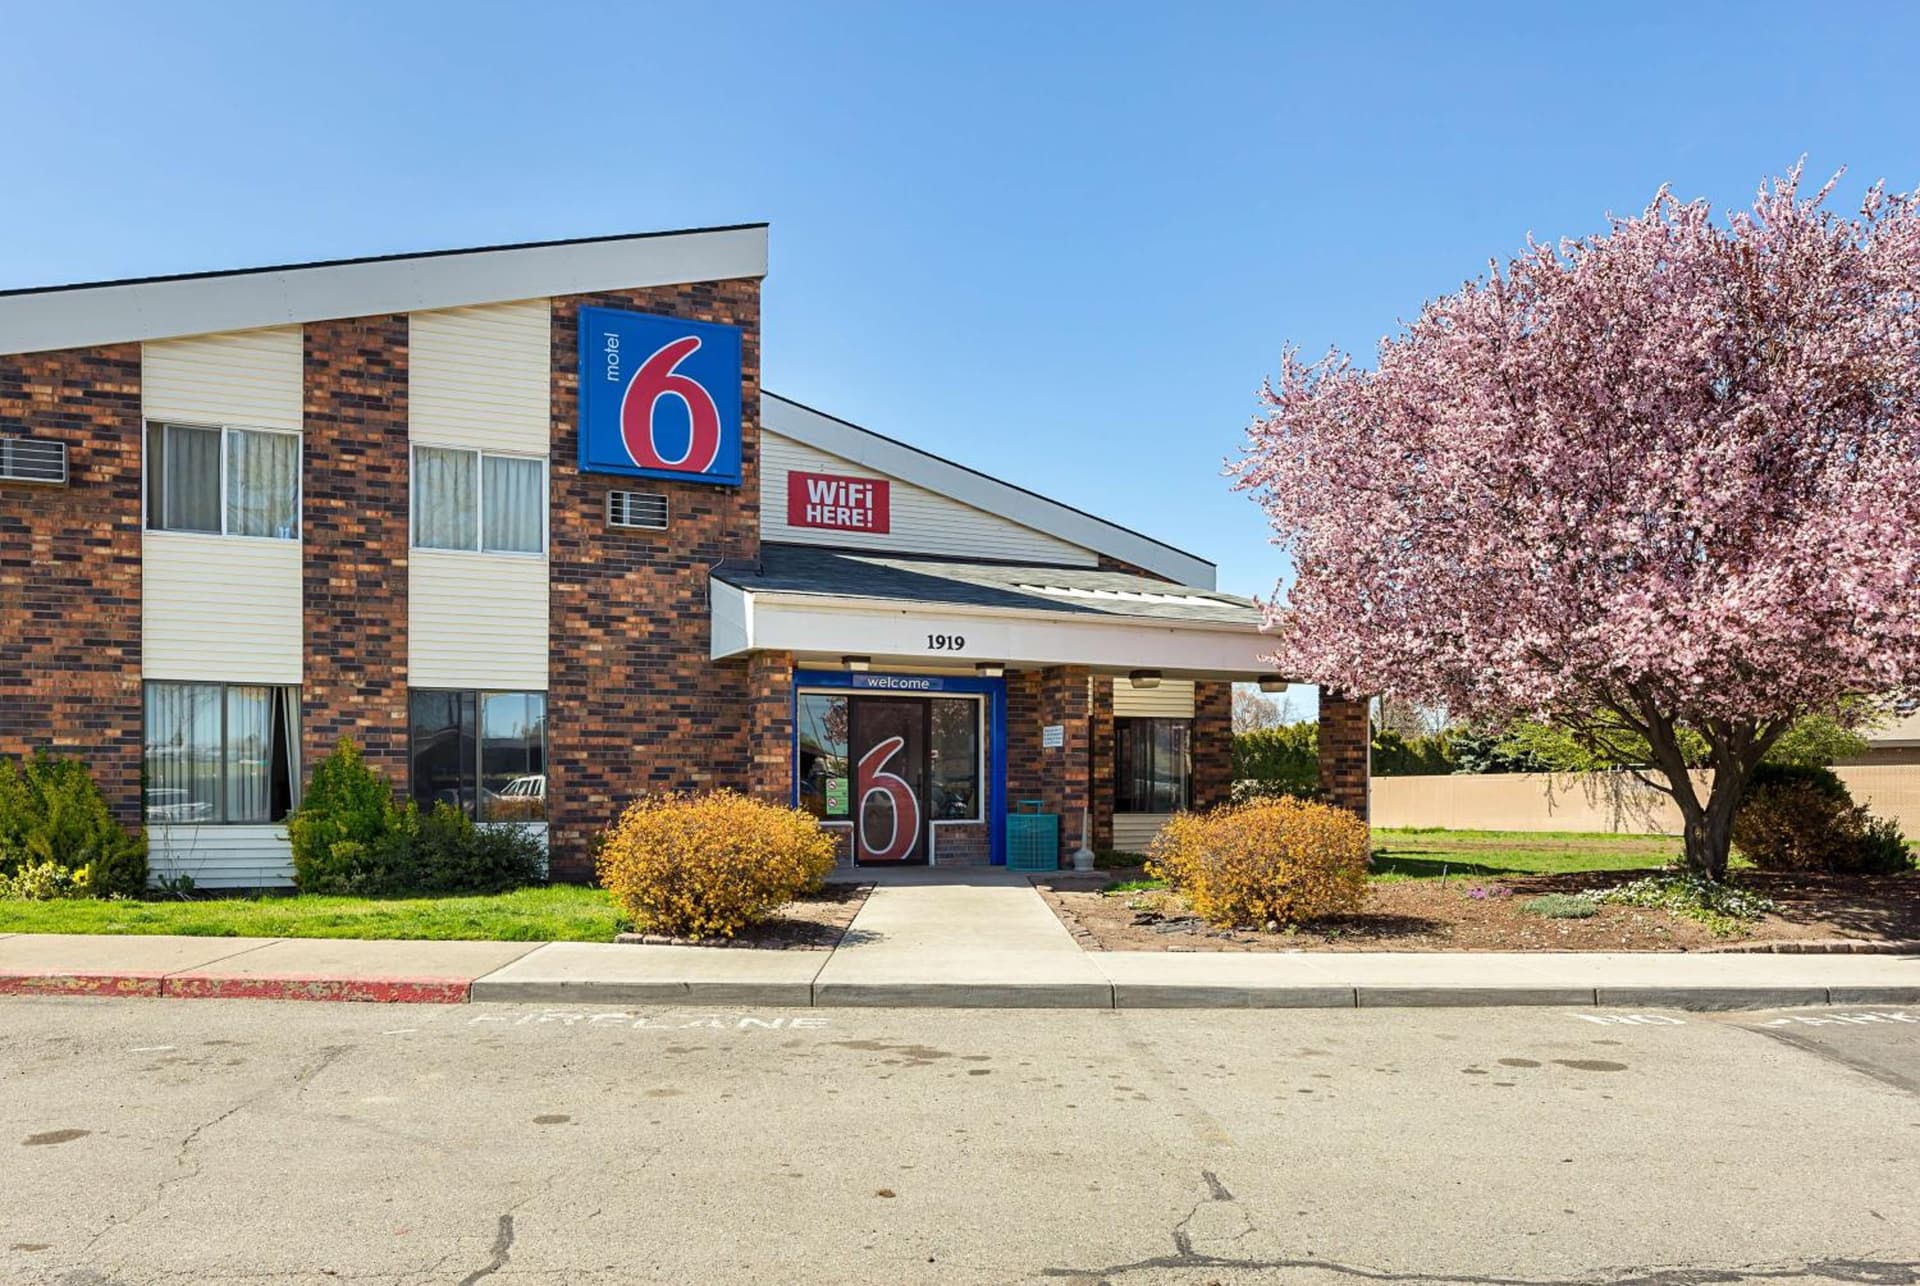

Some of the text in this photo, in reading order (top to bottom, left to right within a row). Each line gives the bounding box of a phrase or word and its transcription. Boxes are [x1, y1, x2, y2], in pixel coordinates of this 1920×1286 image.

[603, 332, 620, 382] motel
[620, 335, 721, 473] 6
[806, 479, 873, 508] WiFi
[806, 504, 873, 528] HERE!
[927, 634, 965, 651] 1919
[867, 676, 930, 689] welcome
[858, 736, 920, 860] 6
